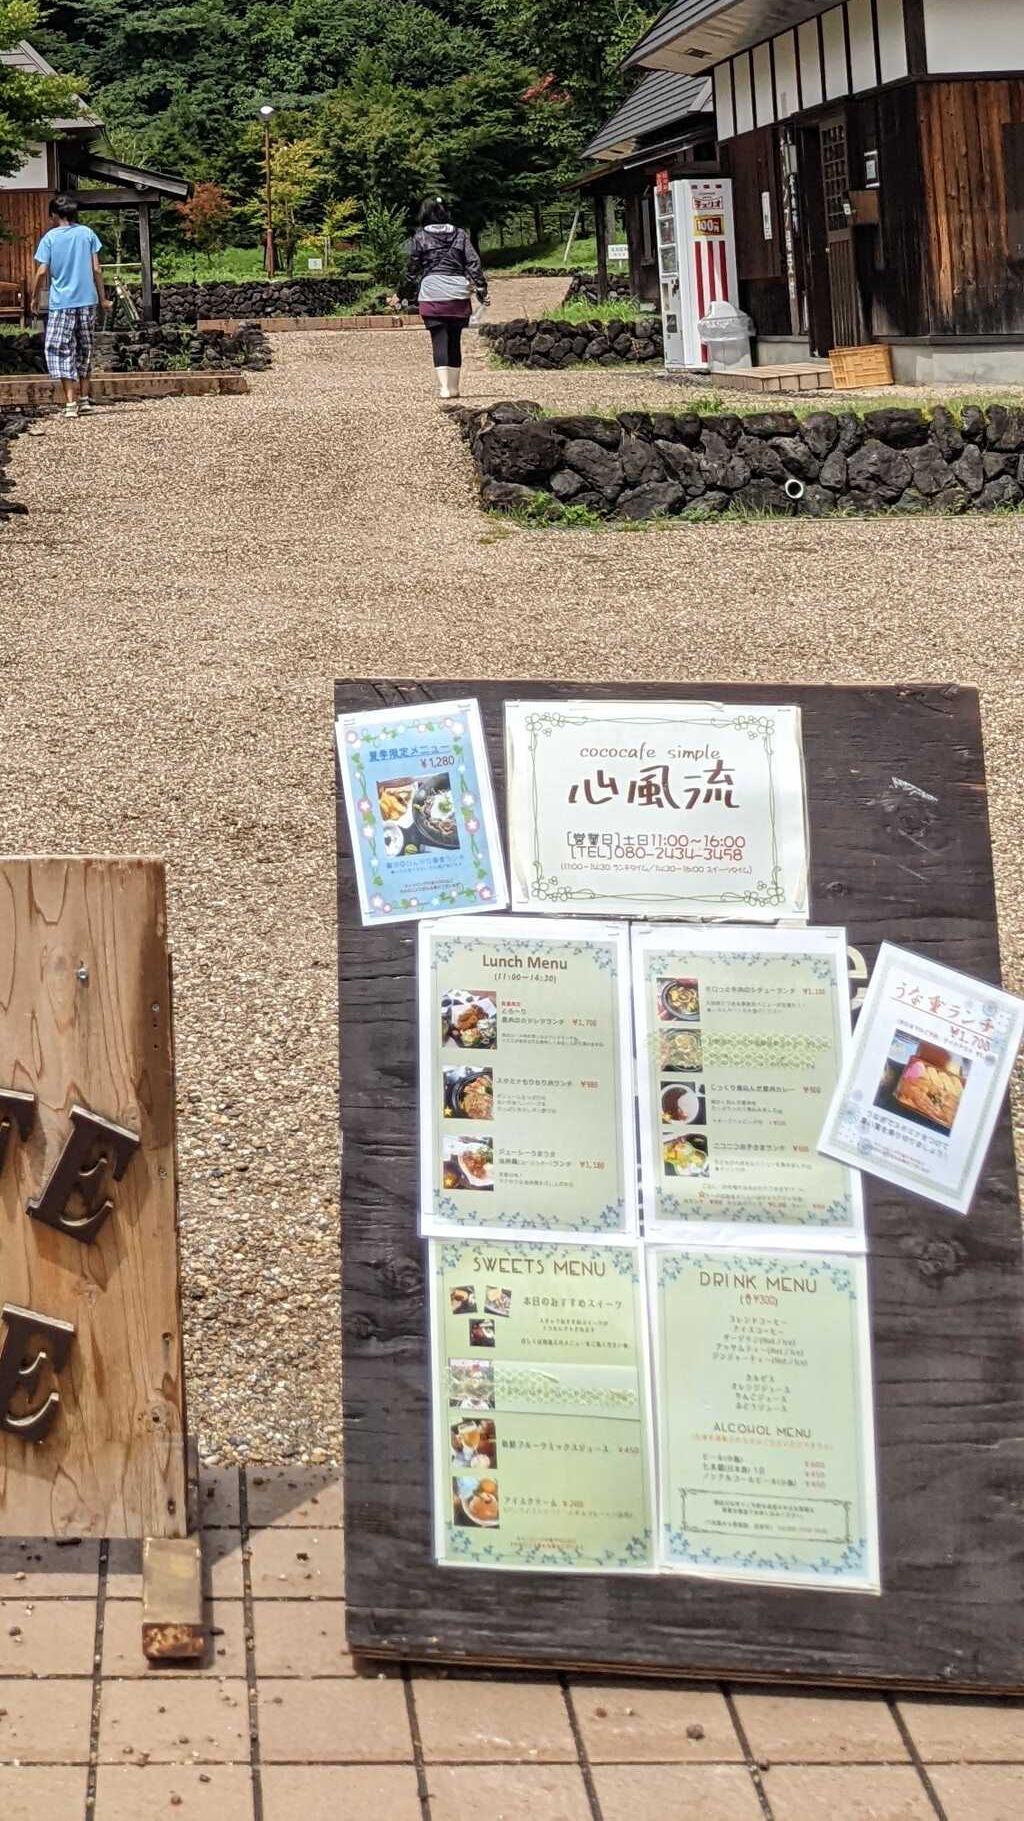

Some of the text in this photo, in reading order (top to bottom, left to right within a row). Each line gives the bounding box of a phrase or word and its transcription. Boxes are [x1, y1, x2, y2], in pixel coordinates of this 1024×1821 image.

[580, 742, 721, 761] cococafe simple
[568, 759, 740, 809] 心風流
[482, 954, 568, 970] Lunch Menu
[895, 982, 995, 1034] うな重ランチ
[473, 1257, 606, 1277] SWEETS MENU
[699, 1272, 817, 1293] DRINK MENU
[523, 1295, 623, 1310] 本日のおすすめスイーツ
[714, 1421, 812, 1439] ALCOHOL MENU
